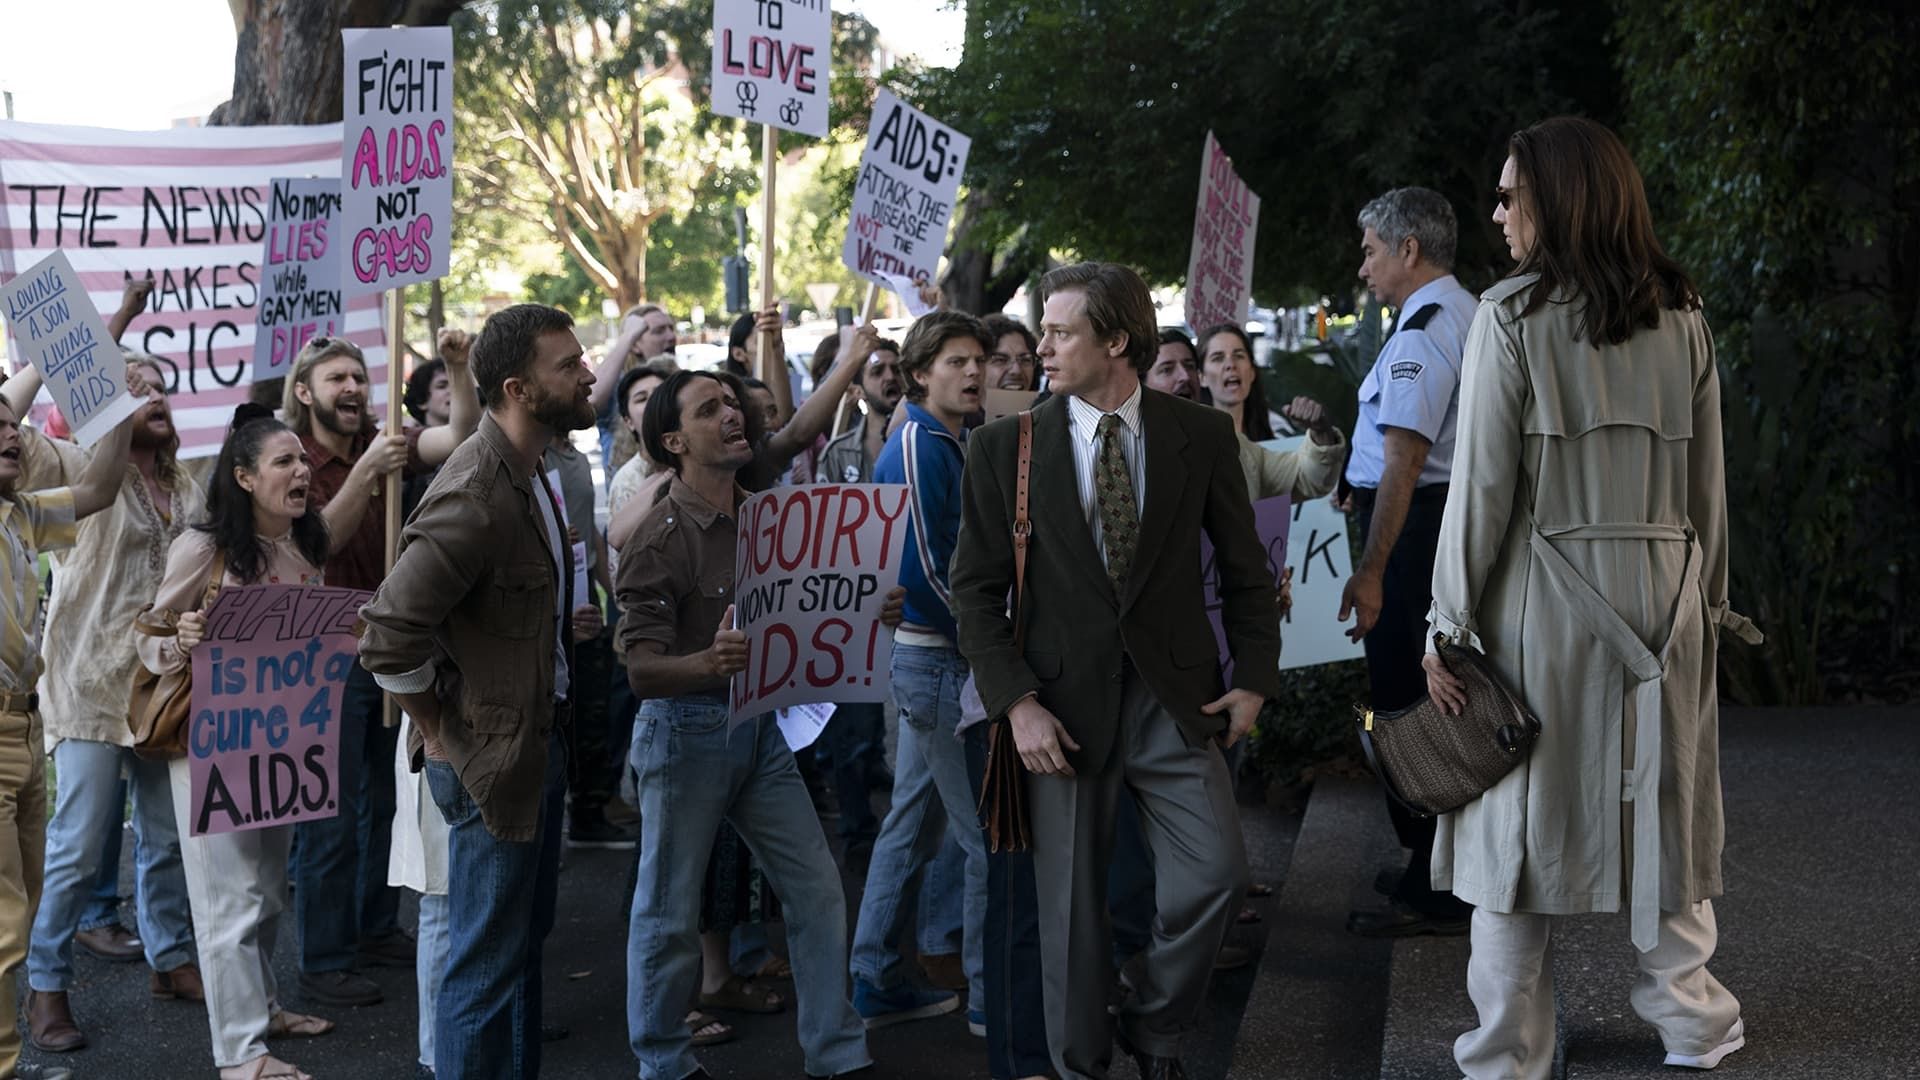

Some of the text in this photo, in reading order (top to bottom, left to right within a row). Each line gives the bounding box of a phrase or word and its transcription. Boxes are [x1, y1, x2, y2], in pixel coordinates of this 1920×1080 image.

[755, 0, 782, 29] TO
[722, 28, 816, 94] LOVE
[351, 119, 446, 190] A.I.D.S.
[873, 104, 958, 184] AIDS:
[9, 184, 266, 248] THE NEWS
[272, 179, 300, 222] No
[376, 187, 420, 224] NOT
[858, 163, 948, 227] ATTACK THE
[871, 200, 930, 242] DISEASE
[269, 217, 330, 265] LIES
[353, 213, 433, 283] GAYS
[855, 212, 914, 256] NOT THE
[8, 267, 64, 320] LOVING
[273, 265, 307, 294] while
[29, 298, 70, 341] A SON
[261, 290, 341, 327] GAY MEN
[42, 321, 93, 374] LIVING
[64, 351, 94, 384] WITH
[69, 367, 116, 423] AIDS
[737, 486, 908, 592] BIGOTRY
[202, 588, 374, 643] HATE
[798, 573, 878, 612] STOP
[210, 637, 356, 695] is not a
[300, 686, 332, 736] 4
[197, 744, 336, 834] A.I.D.S.
